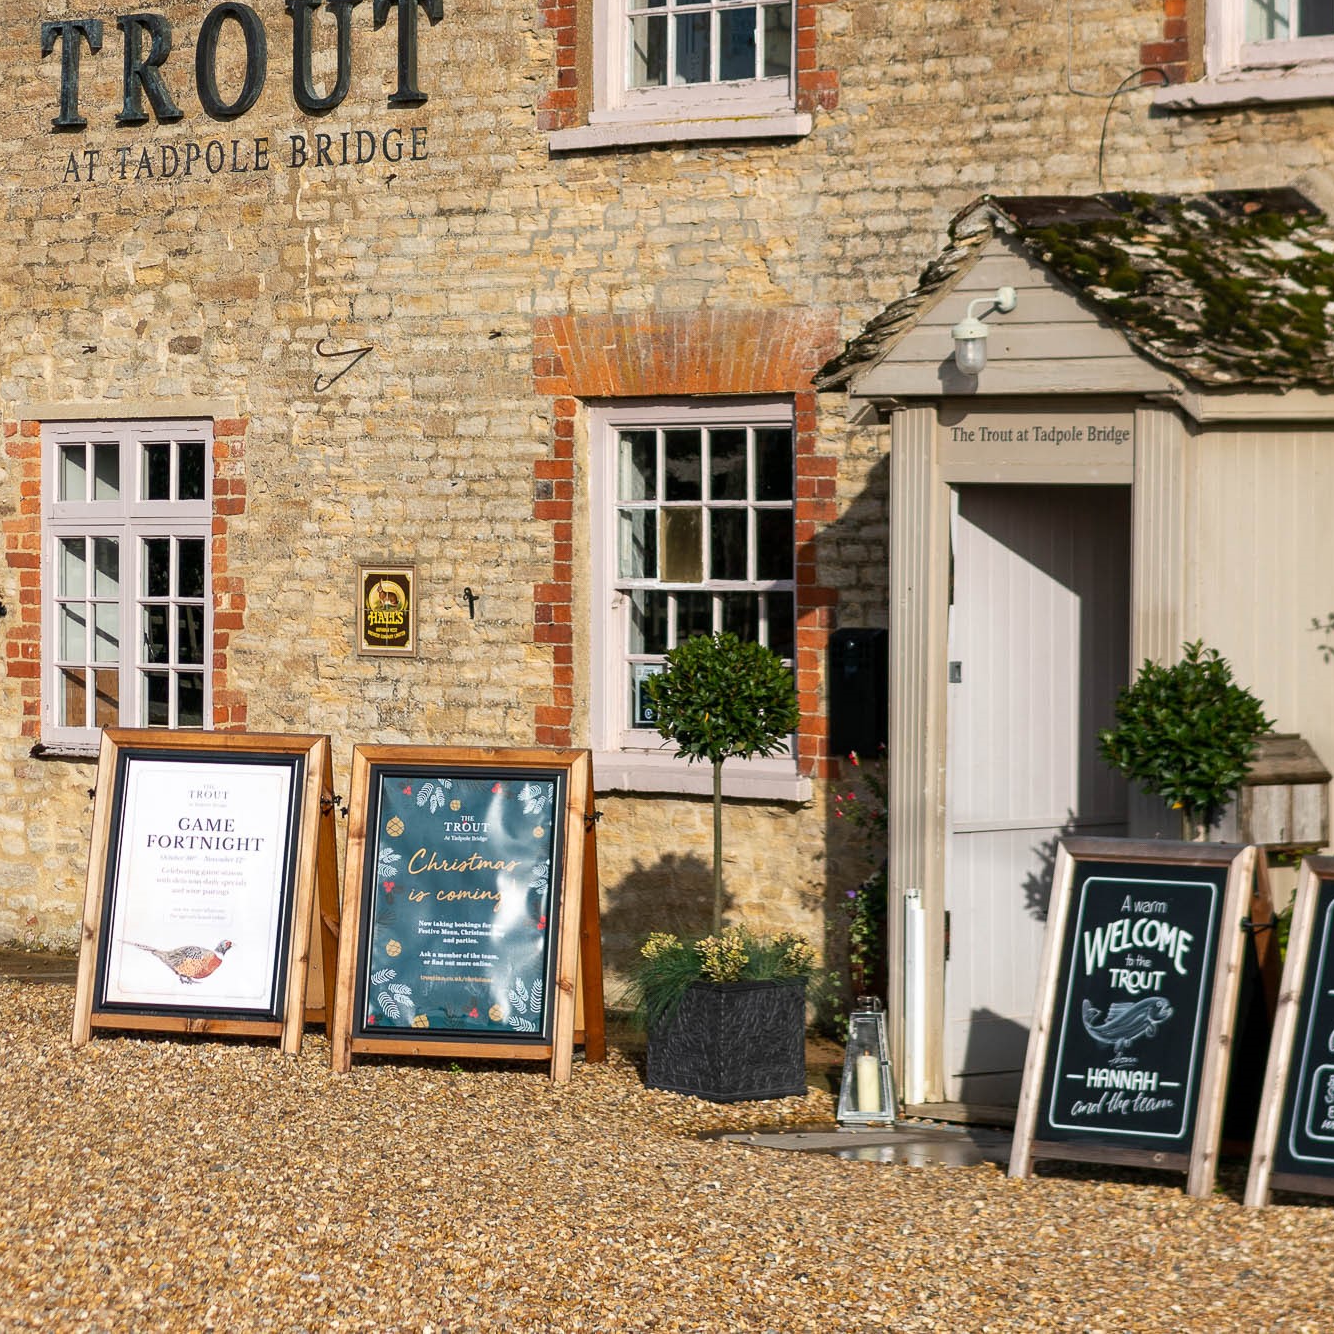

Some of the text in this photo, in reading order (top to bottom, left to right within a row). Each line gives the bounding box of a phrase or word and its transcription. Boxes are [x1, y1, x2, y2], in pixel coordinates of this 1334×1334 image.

[62, 127, 430, 183] AT TADPOLE BRIDGE
[951, 426, 1130, 445] The Trout at Tadpole Bridge
[189, 790, 229, 800] TROUT
[178, 817, 235, 833] GAME
[443, 821, 490, 833] TROUT
[146, 834, 265, 852] FORTNIGHT
[408, 847, 522, 875] Christmas
[408, 888, 504, 913] is coming
[1120, 895, 1167, 914] A warm
[1083, 917, 1194, 976] WELCOME
[1125, 953, 1152, 967] to the
[1108, 968, 1166, 994] TROUT
[1086, 1067, 1159, 1091] HANNAH
[1070, 1090, 1176, 1116] and the team
